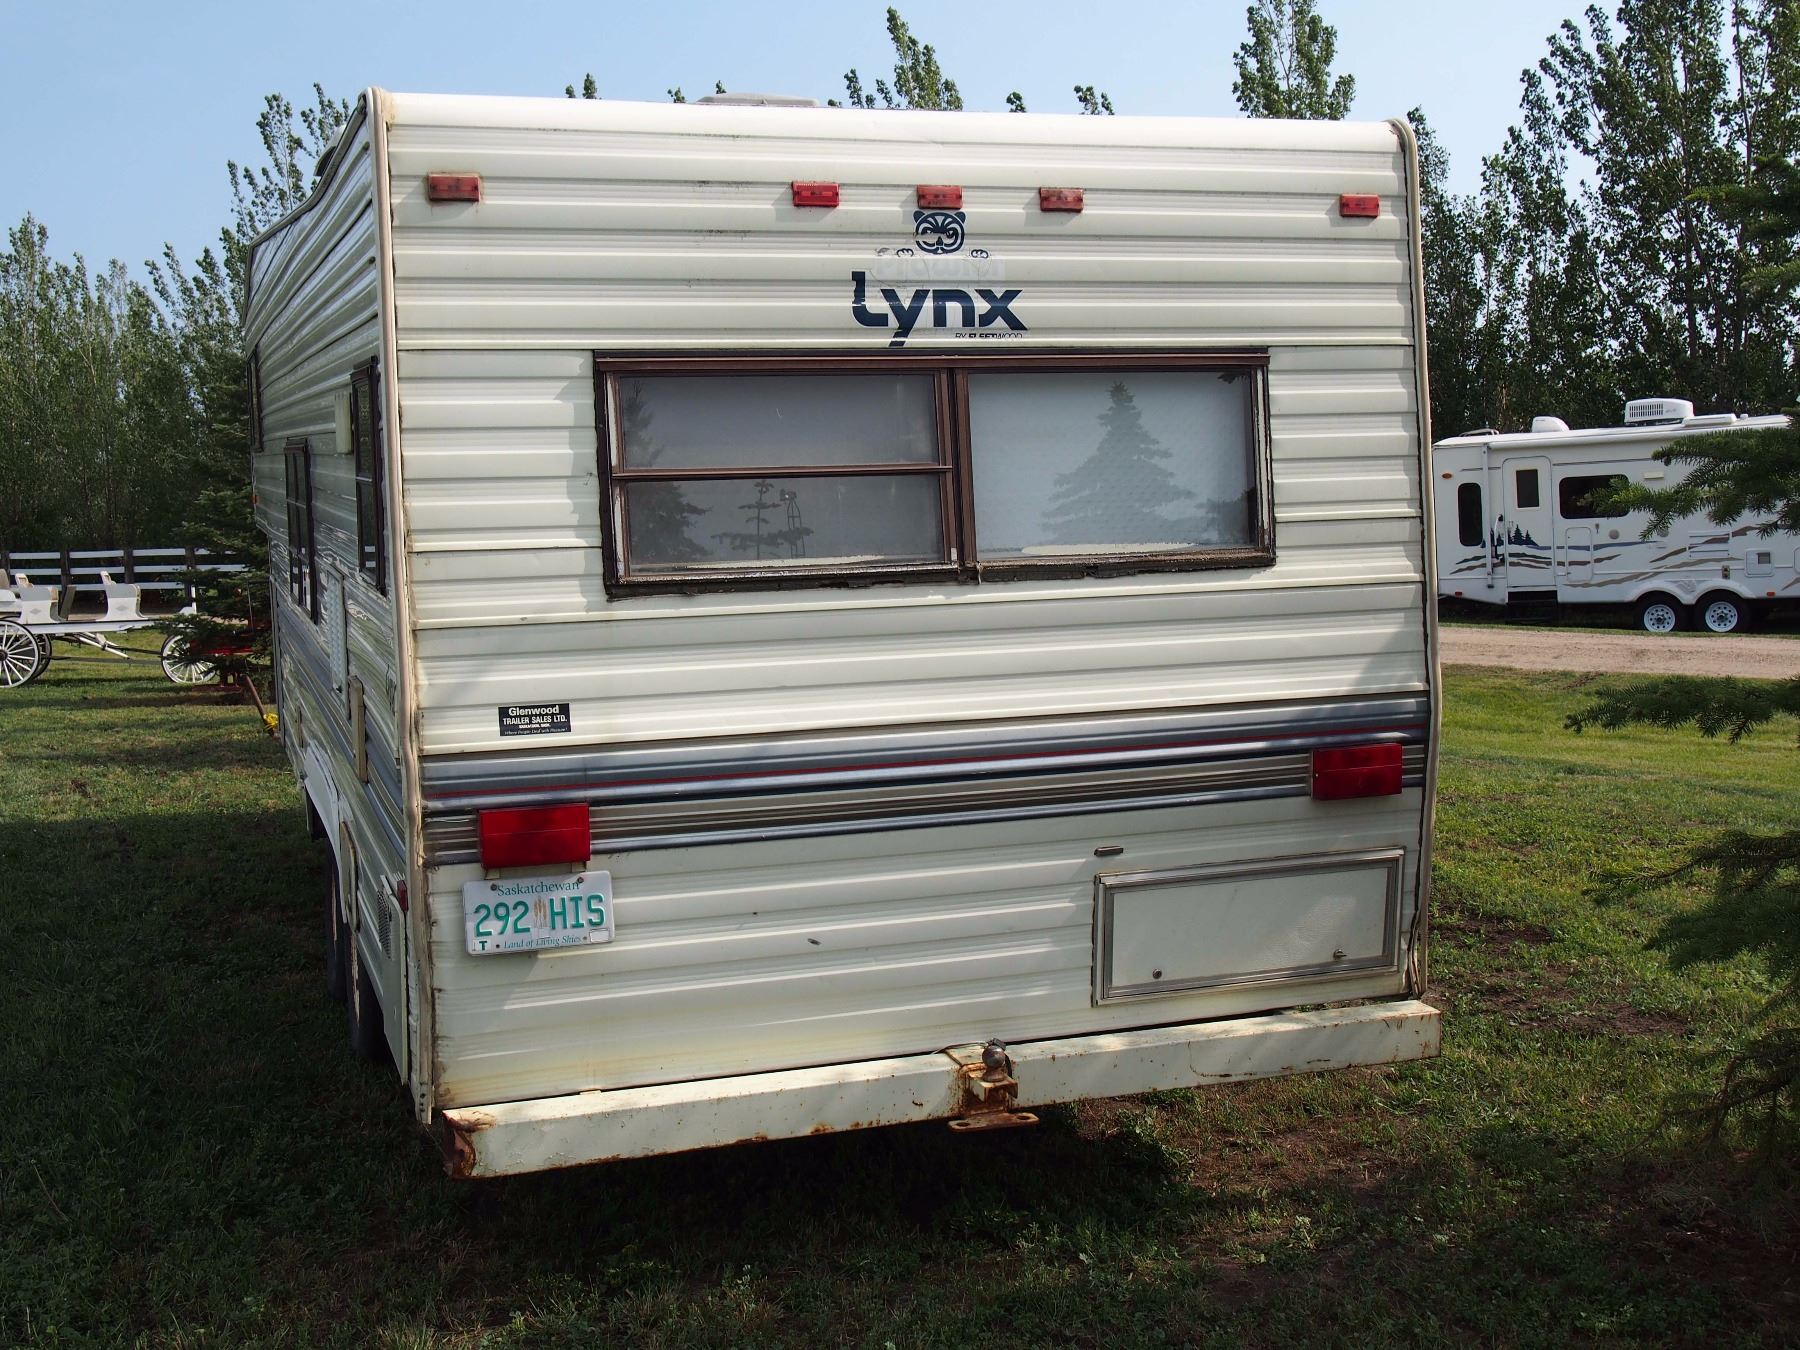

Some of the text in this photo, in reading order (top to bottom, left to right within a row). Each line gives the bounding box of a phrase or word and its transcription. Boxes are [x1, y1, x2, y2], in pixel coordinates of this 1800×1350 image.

[851, 271, 1028, 347] Lynx
[508, 705, 559, 716] Glenwood
[503, 717, 529, 725] TRAILER
[497, 880, 580, 897] Saskatchewan
[473, 892, 605, 937] 292 HIS
[478, 940, 488, 951] T
[504, 940, 524, 950] Land
[525, 938, 534, 949] of
